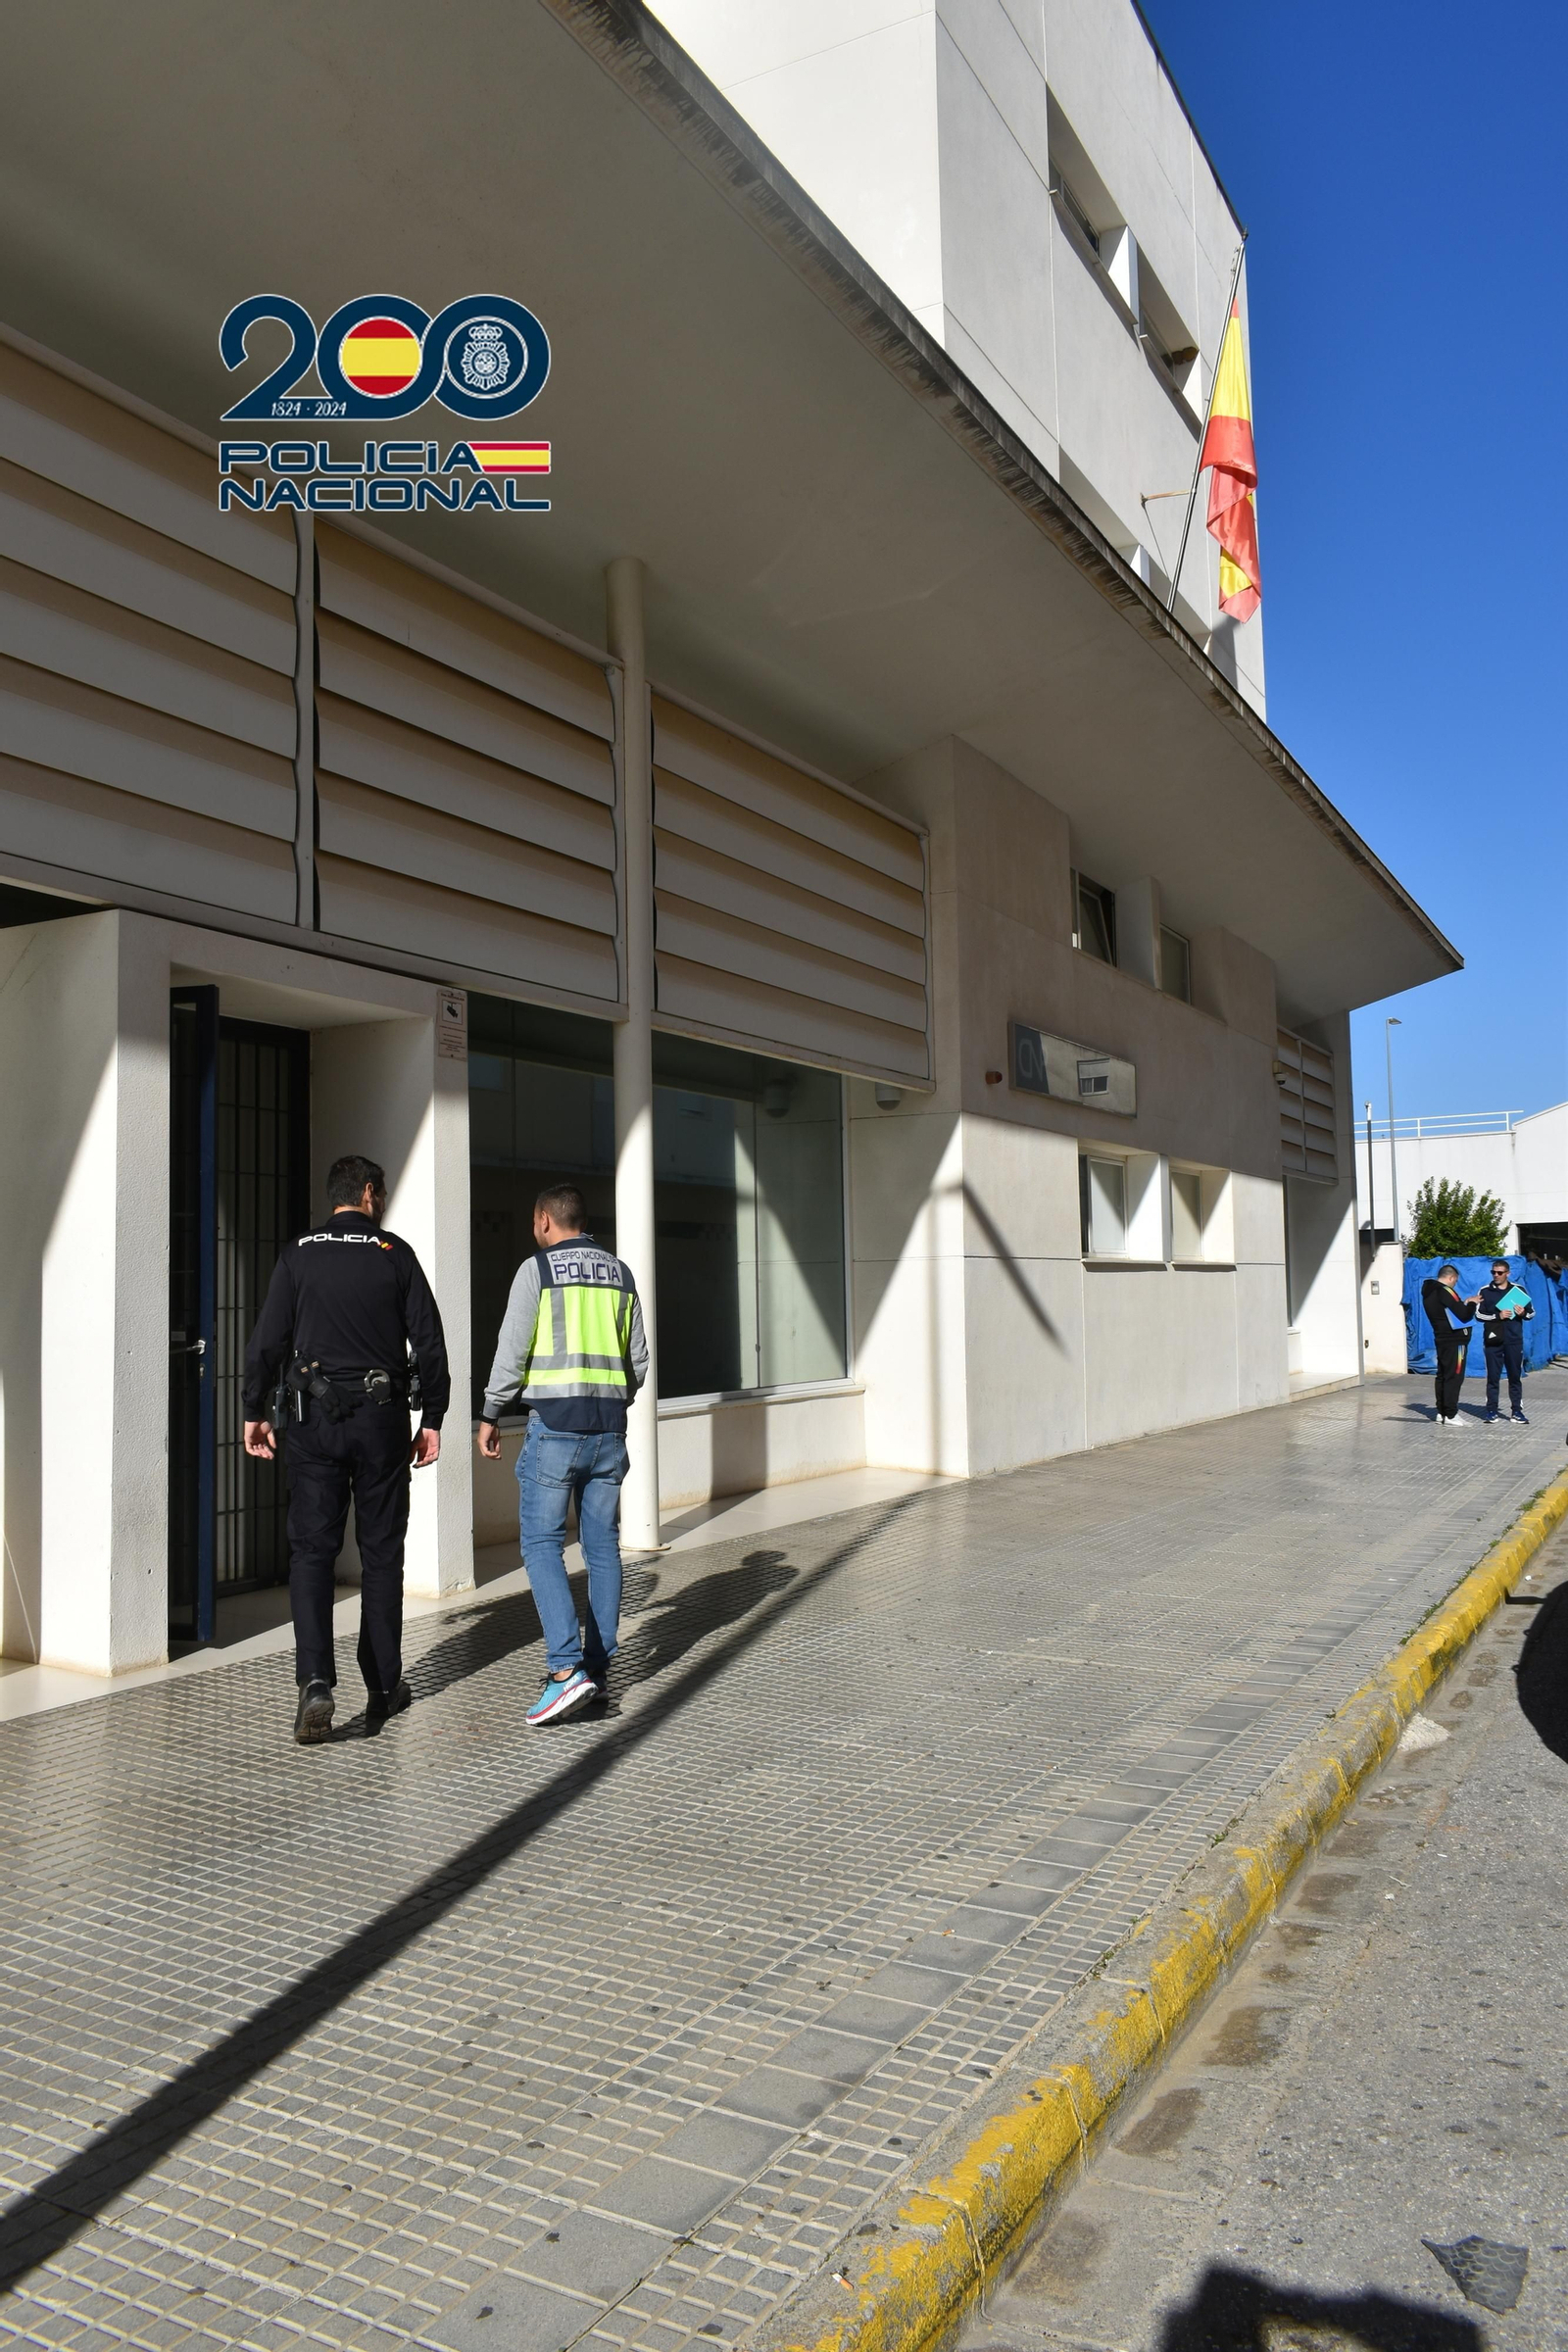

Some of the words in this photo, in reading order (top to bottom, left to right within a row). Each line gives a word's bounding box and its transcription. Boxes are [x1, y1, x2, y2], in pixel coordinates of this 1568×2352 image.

[298, 1233, 381, 1247] POLICIA
[551, 1251, 580, 1261] CUERPO
[581, 1251, 610, 1262] NACIONAL
[554, 1262, 621, 1283] POLICIA
